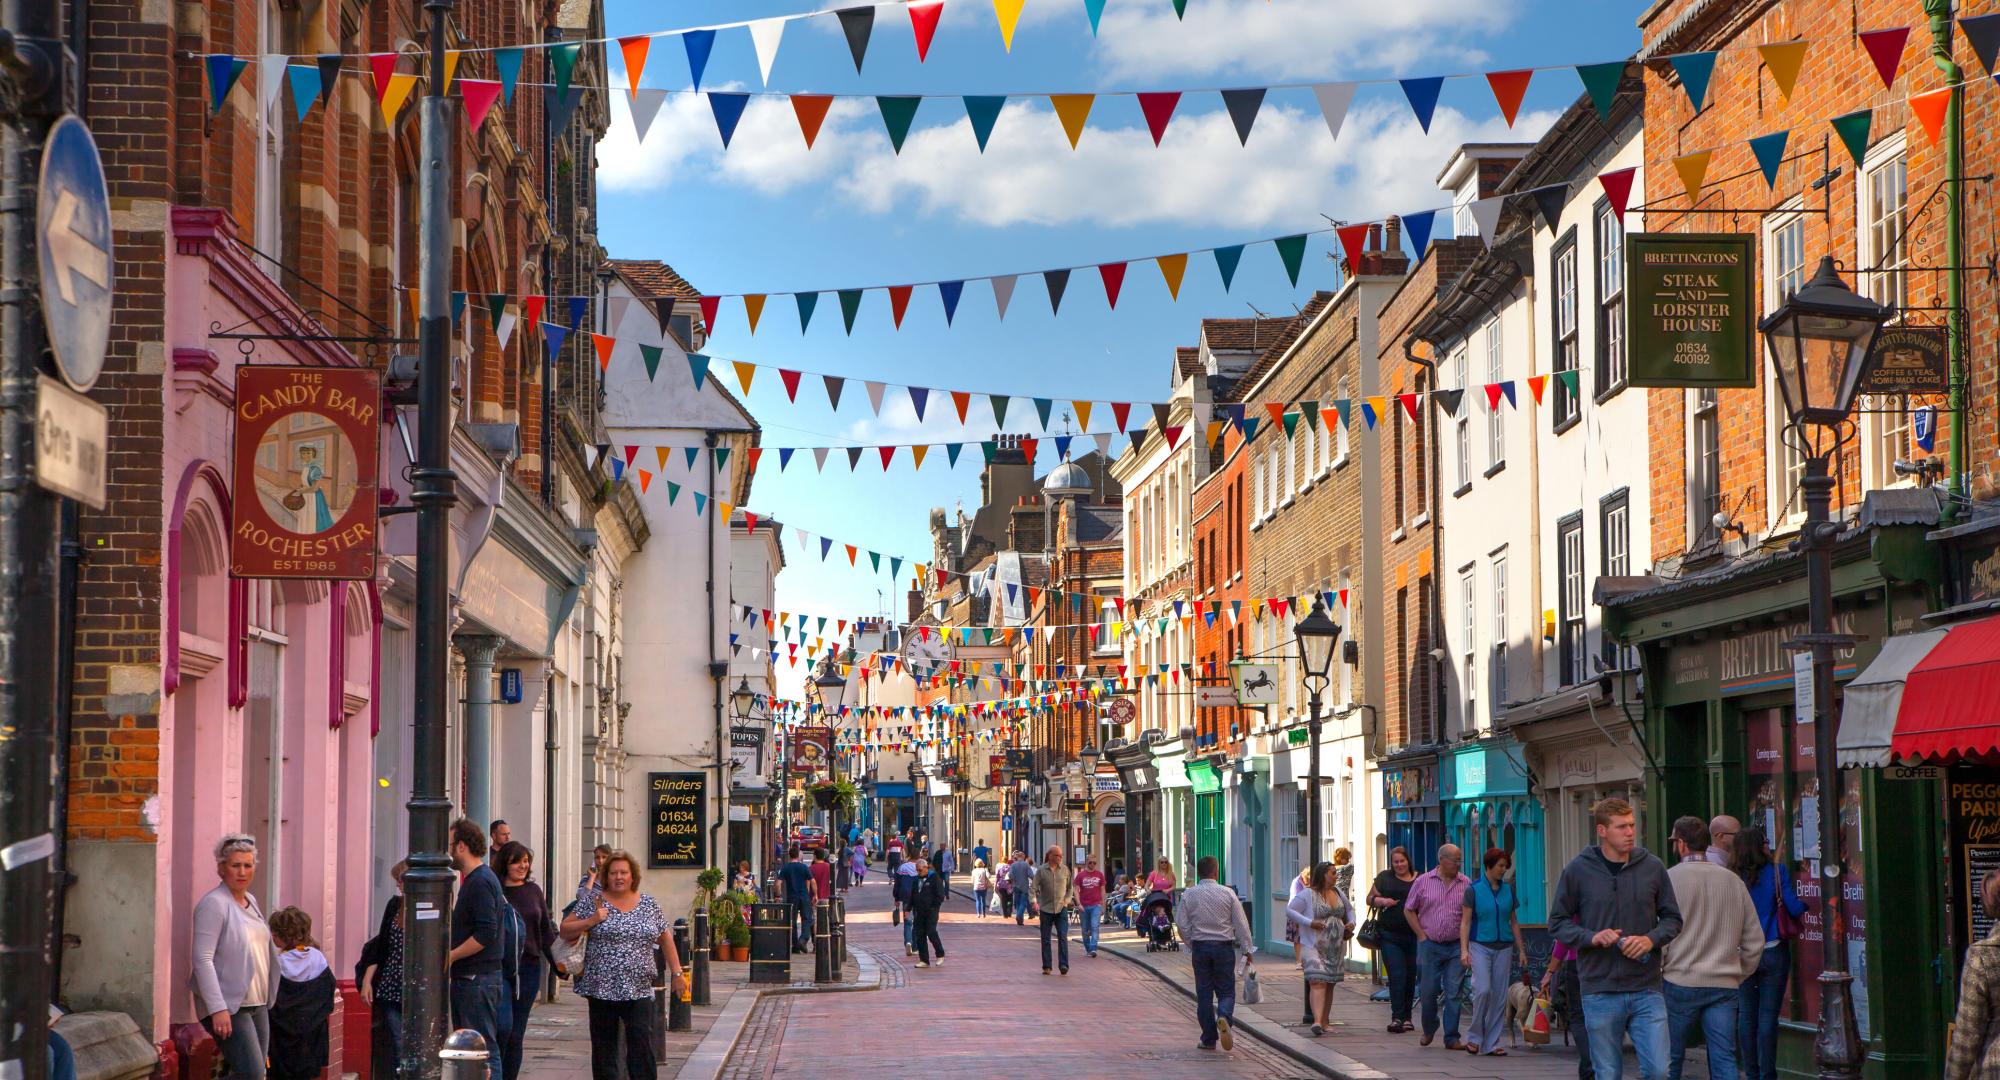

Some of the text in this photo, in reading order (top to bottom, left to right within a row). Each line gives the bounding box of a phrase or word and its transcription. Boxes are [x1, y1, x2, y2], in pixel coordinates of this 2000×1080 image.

[1644, 252, 1739, 264] BRETTINGTONS
[1662, 274, 1719, 287] STEAK
[1676, 290, 1708, 301] AND
[1652, 303, 1730, 317] LOBSTER
[1662, 318, 1722, 332] HOUSE
[1675, 342, 1708, 353] 01634
[1673, 353, 1711, 364] 400192
[1872, 369, 1905, 377] COFFEE
[290, 373, 323, 385] THE
[1871, 377, 1915, 385] HOME-MADE
[241, 385, 375, 426] CANDY BAR
[40, 408, 72, 465] One
[237, 519, 372, 557] ROCHESTER
[305, 560, 336, 571] 1985
[731, 732, 759, 741] TOPES
[1756, 749, 1771, 760] Coming
[1800, 744, 1815, 757] Coming
[1896, 768, 1937, 778] COFFEE
[652, 779, 703, 790] Slinders
[1952, 783, 2000, 799] PEGG
[658, 794, 697, 805] Florist
[660, 811, 694, 822] 01634
[656, 824, 698, 834] 846244
[657, 852, 688, 860] Interflora
